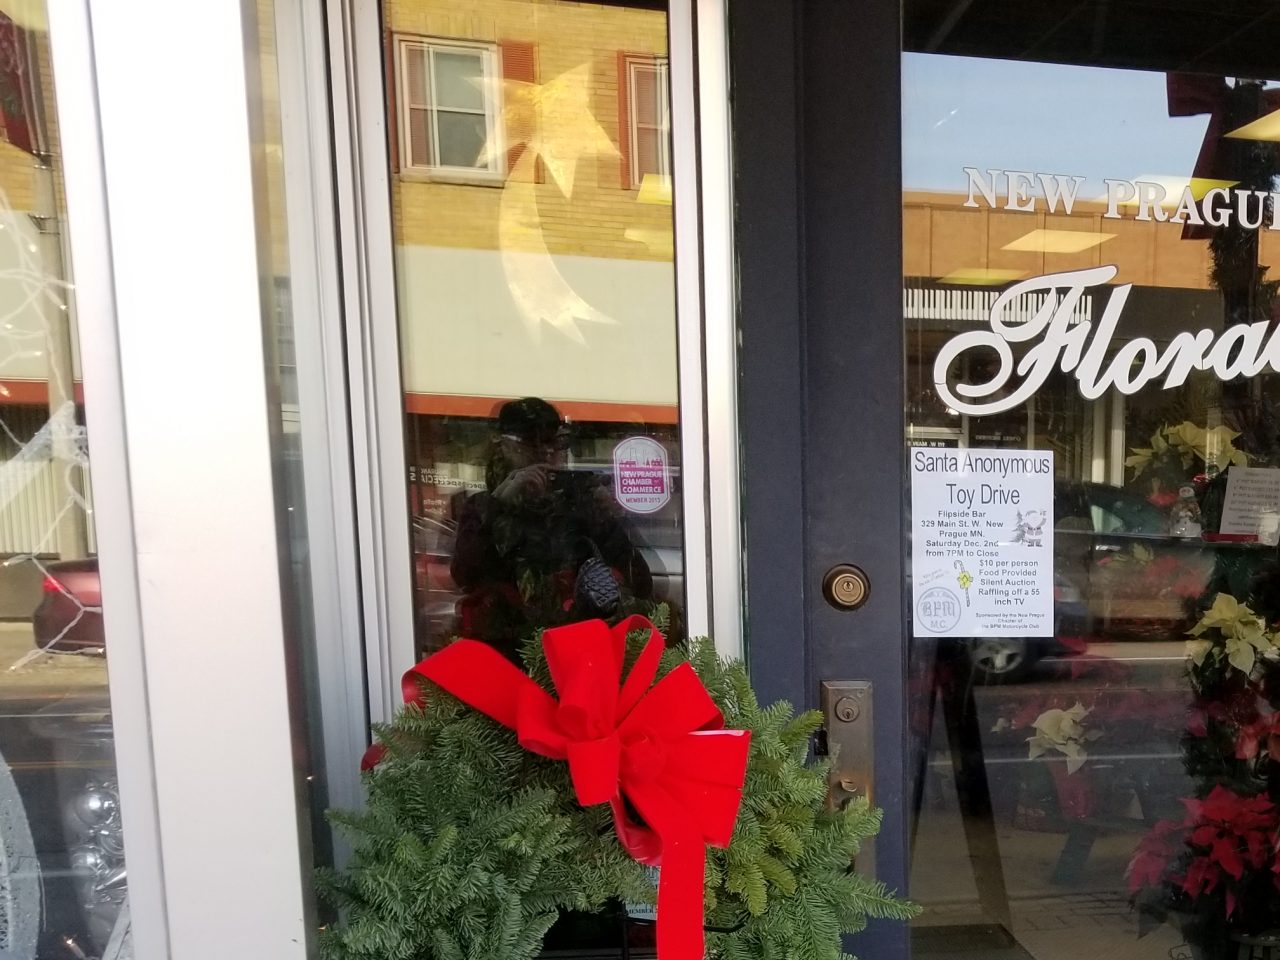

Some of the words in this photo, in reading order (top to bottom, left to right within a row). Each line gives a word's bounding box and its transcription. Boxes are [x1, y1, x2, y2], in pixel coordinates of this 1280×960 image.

[962, 167, 1086, 215] NEW
[914, 451, 958, 473] Santa
[962, 452, 1050, 478] Anonymous
[621, 470, 637, 478] NEW
[637, 470, 663, 478] PRAGUE
[946, 483, 975, 509] Toy
[980, 484, 1020, 505] Drive
[938, 510, 970, 519] Flipside
[972, 510, 986, 518] Bar
[921, 520, 935, 528] 329
[958, 520, 969, 528] St.
[986, 520, 1004, 528] New
[939, 530, 968, 539] Prague
[970, 530, 985, 538] MN.
[926, 540, 962, 549] Saturday
[926, 549, 944, 557] from
[976, 549, 999, 557] Close
[979, 559, 994, 567] $10
[996, 560, 1009, 568] per
[1011, 560, 1039, 568] person
[978, 588, 1009, 597] Raffling
[1011, 588, 1022, 596] off
[1031, 588, 1040, 596] 55
[921, 601, 955, 617] BPM
